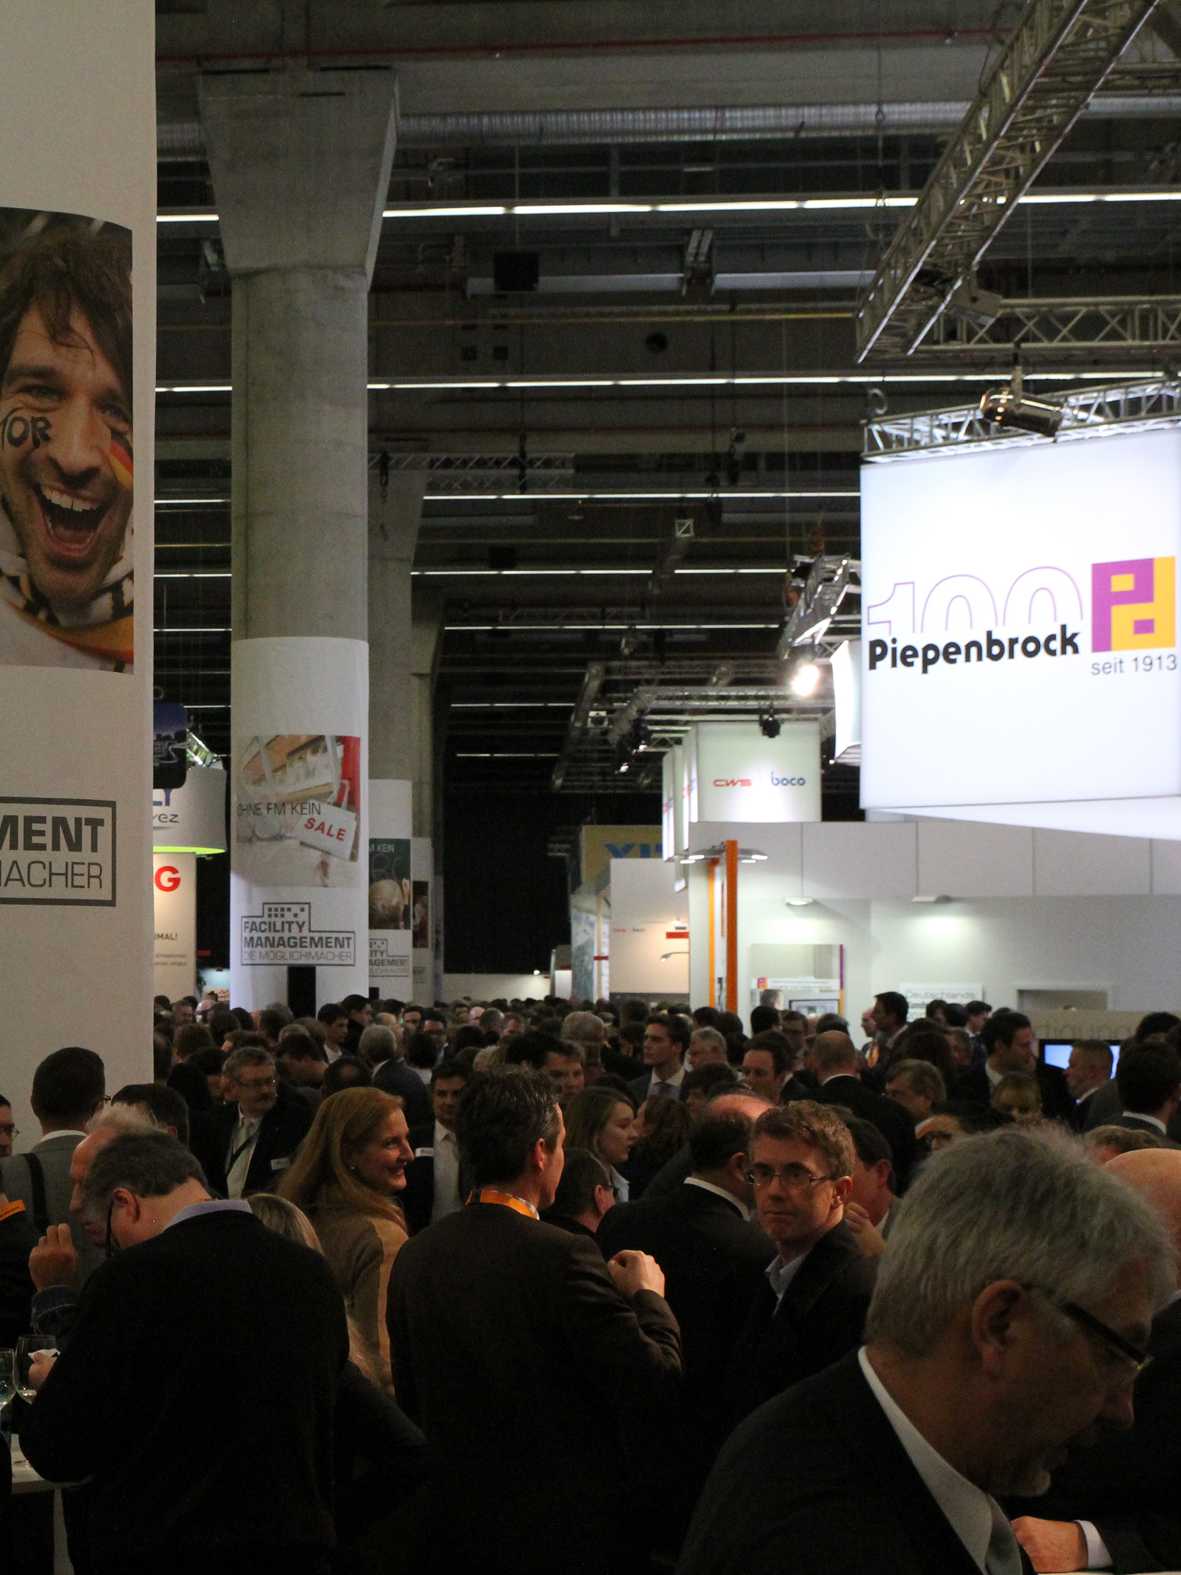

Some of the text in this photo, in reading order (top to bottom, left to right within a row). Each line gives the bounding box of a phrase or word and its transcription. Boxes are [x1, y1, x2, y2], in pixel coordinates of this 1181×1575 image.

[869, 624, 1081, 674] Piepenbrock
[1091, 654, 1178, 676] seit 1913
[771, 771, 806, 787] boco
[237, 802, 322, 818] OHNE FM KEIN
[304, 817, 348, 842] SALE
[154, 866, 181, 892] G
[244, 921, 307, 934] FACILITY
[244, 936, 353, 949] MANAGEMENT
